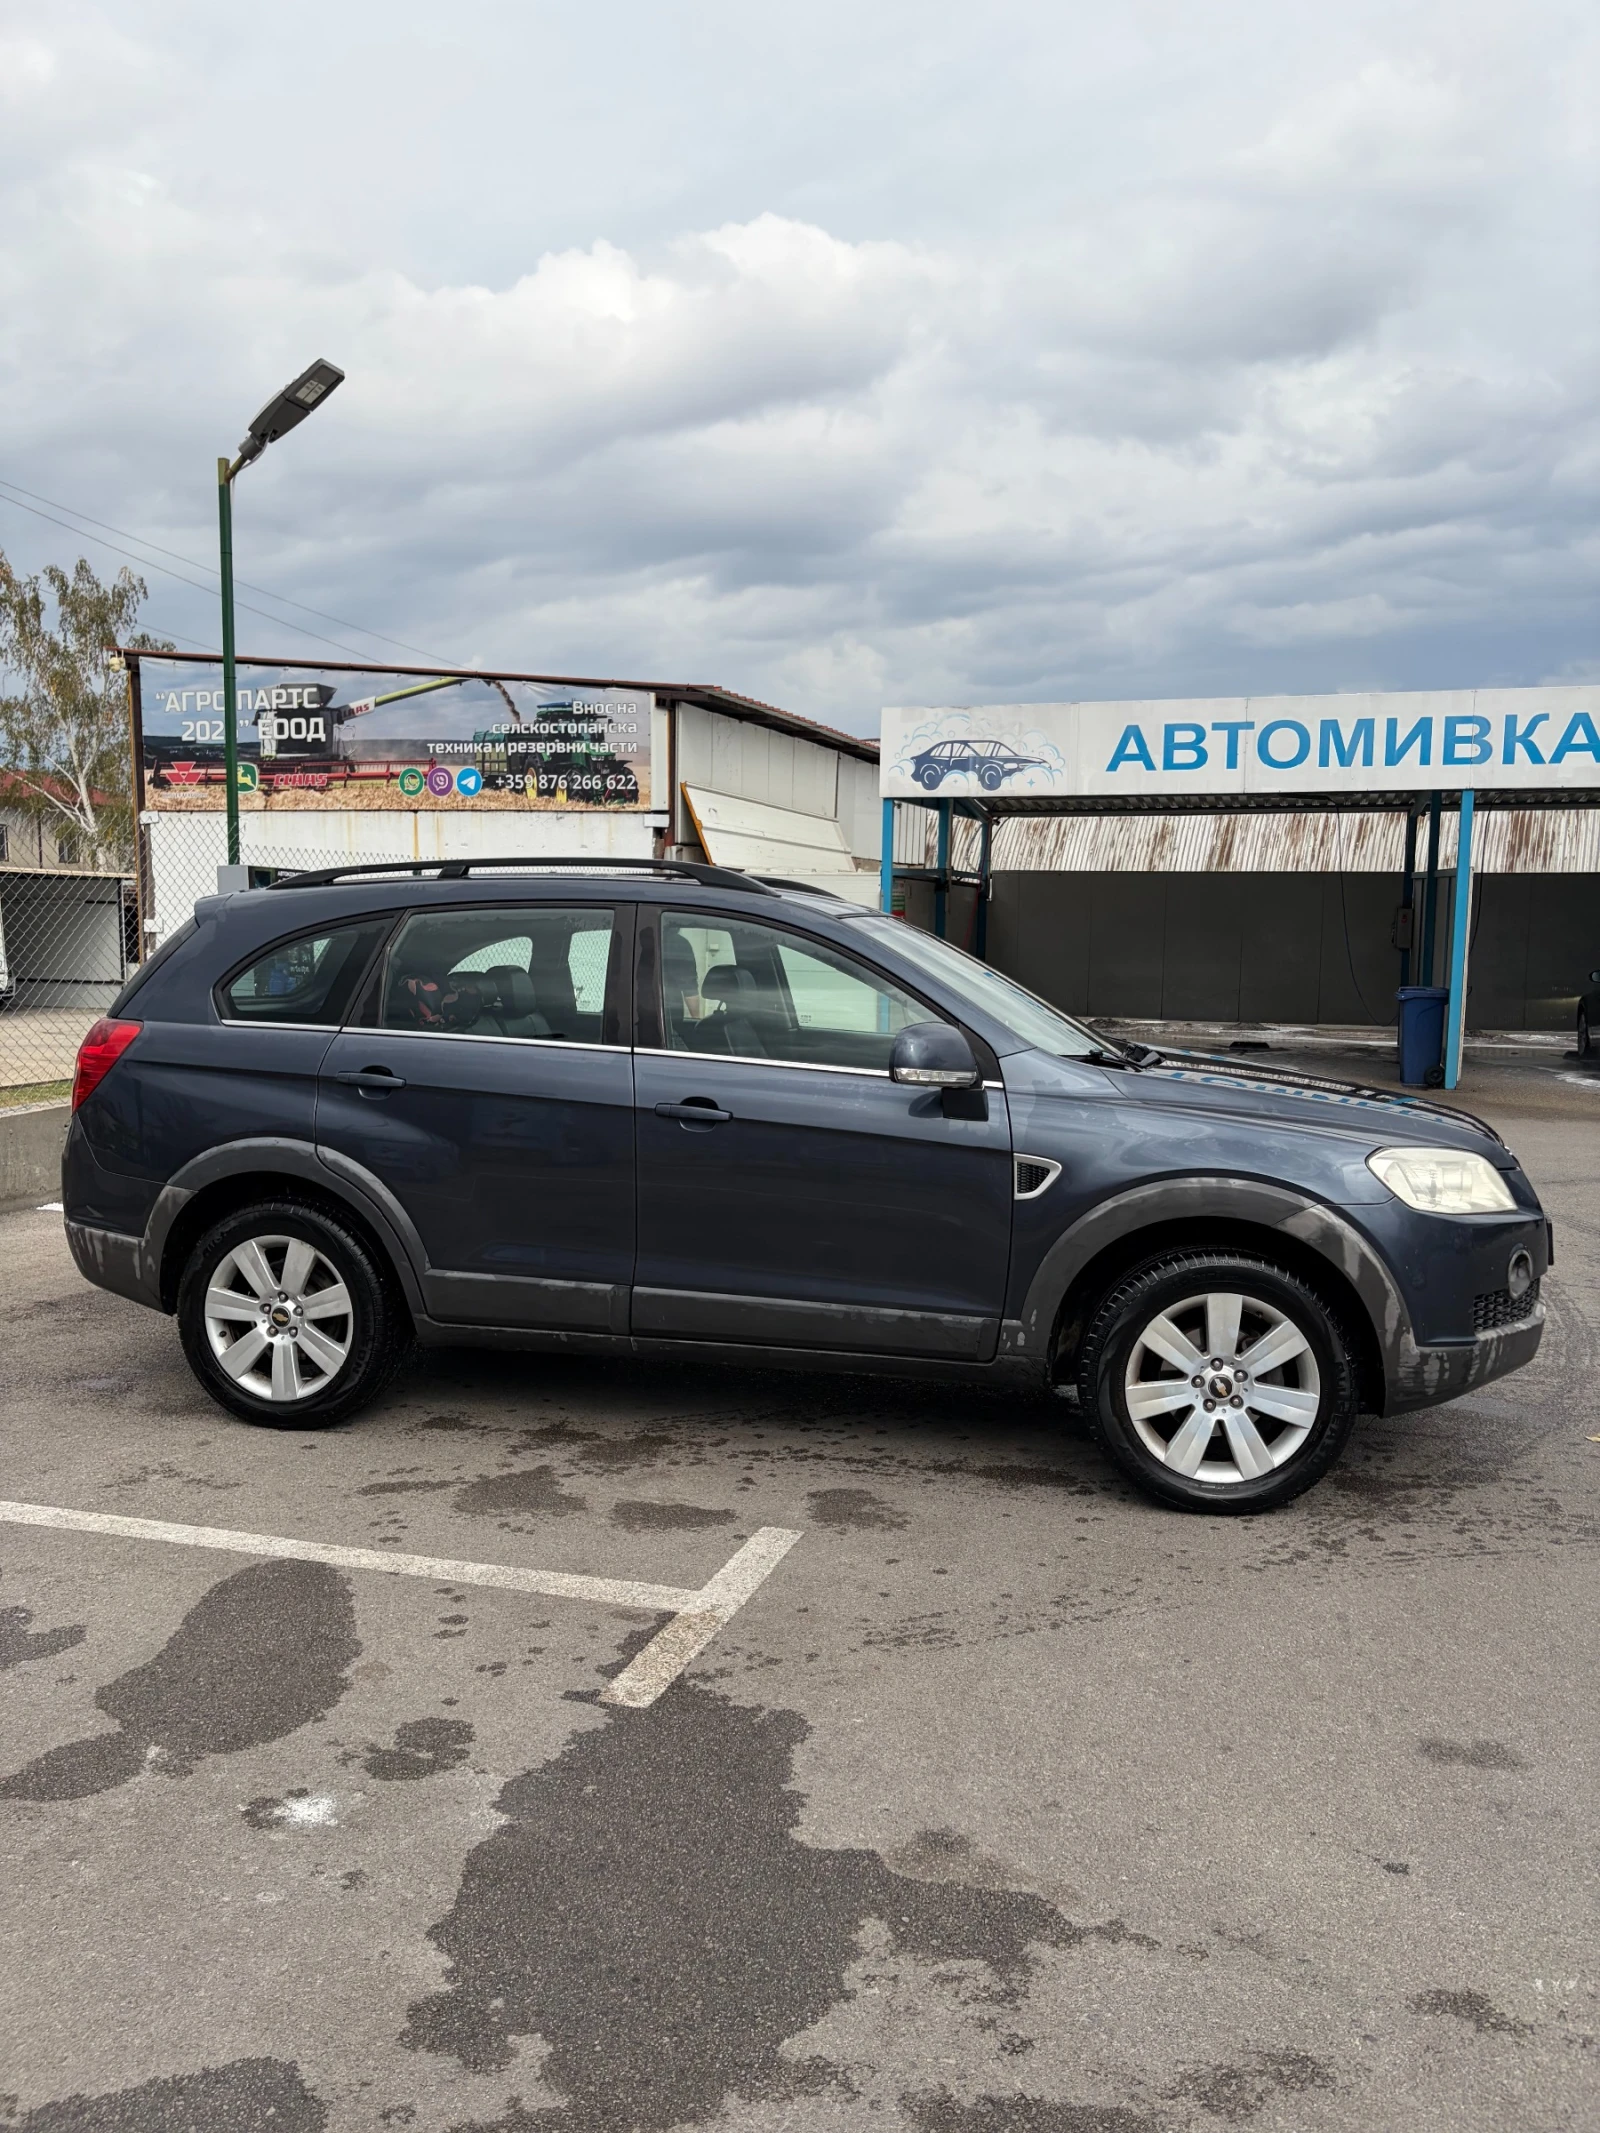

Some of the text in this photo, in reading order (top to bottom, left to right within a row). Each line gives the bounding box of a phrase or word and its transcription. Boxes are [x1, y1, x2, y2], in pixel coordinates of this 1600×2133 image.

[237, 687, 318, 710] ПАРТС
[572, 701, 637, 715] Внос на
[181, 717, 326, 743] 202” ЕООД
[492, 722, 637, 734] селскостопанска
[427, 742, 637, 756] техника и резервни части
[1106, 712, 1600, 772] АВТОМИВКА
[273, 773, 329, 787] CLAAS
[495, 774, 637, 790] +359 876 266 622
